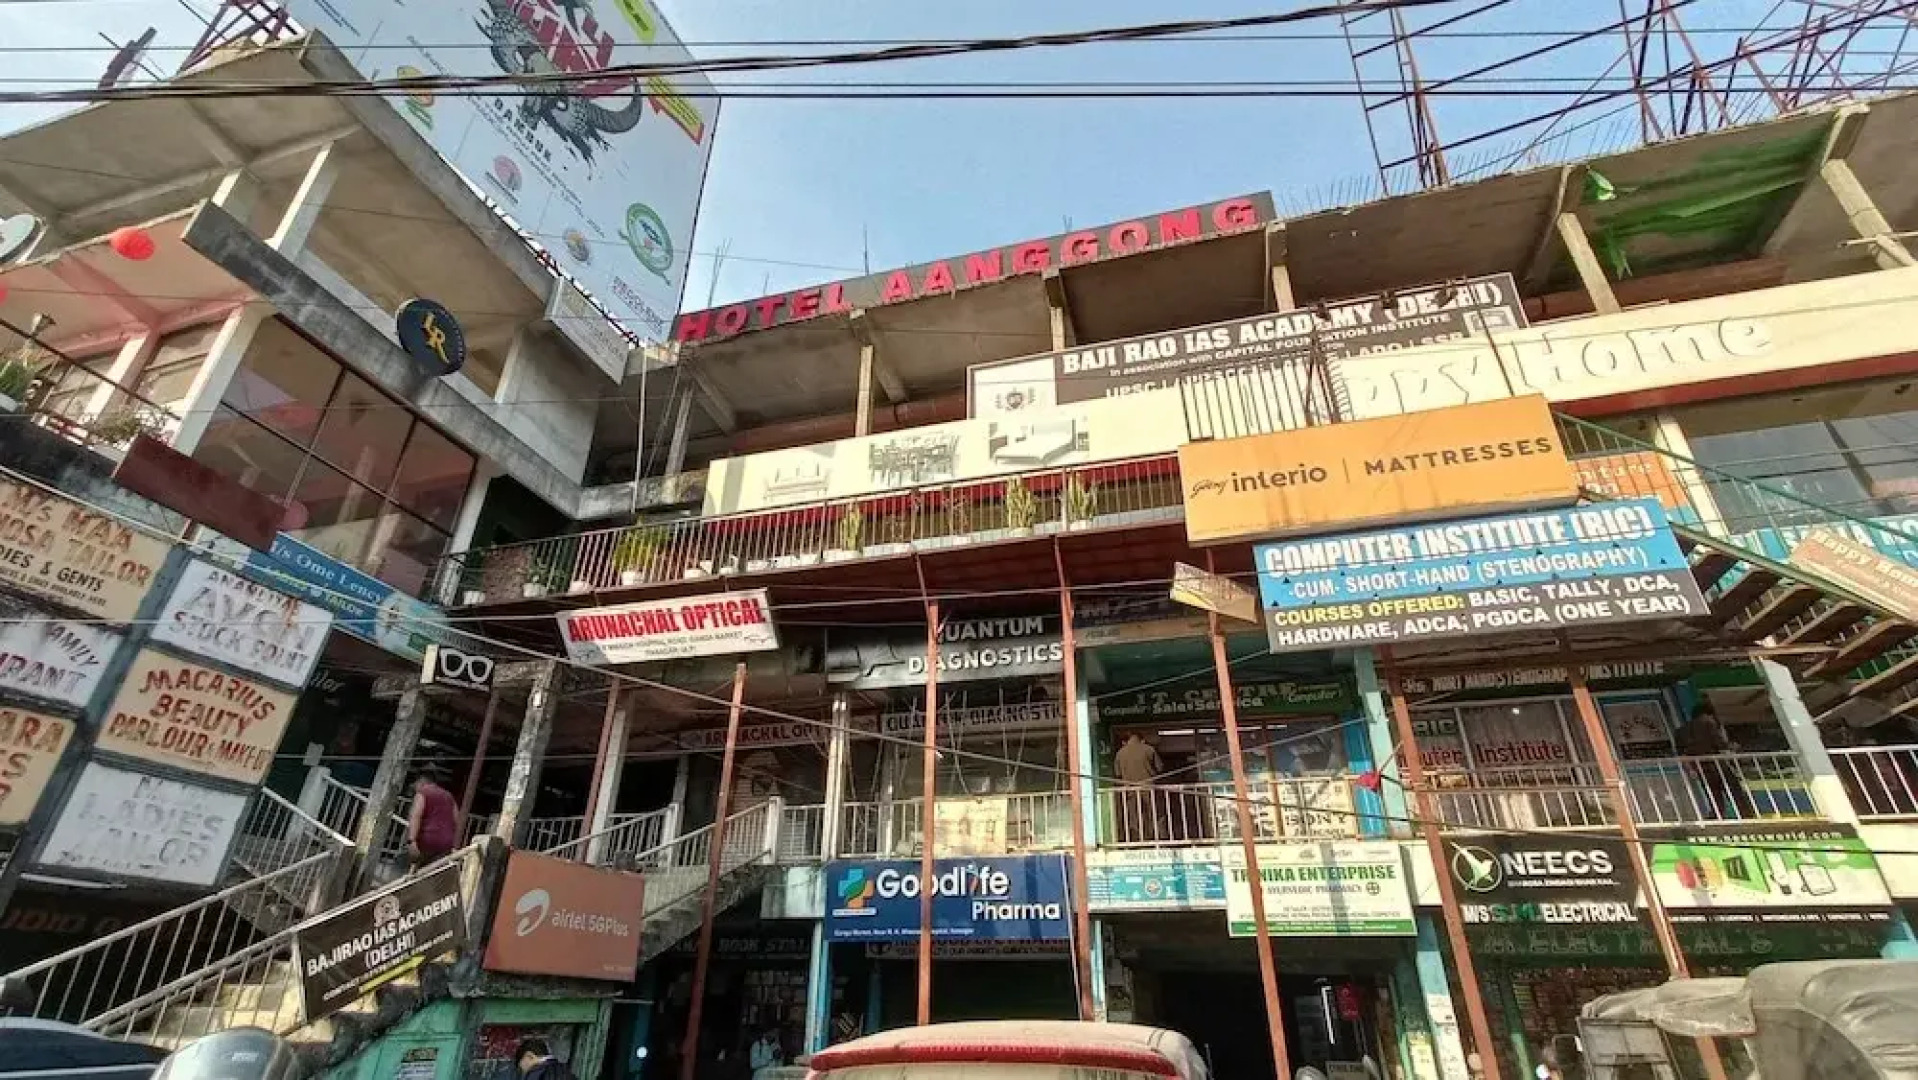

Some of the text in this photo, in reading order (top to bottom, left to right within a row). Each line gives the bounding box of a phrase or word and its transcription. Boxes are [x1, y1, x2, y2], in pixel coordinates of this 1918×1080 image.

[677, 284, 853, 342] HOTEL
[880, 199, 1259, 302] AANGGONG
[1063, 347, 1118, 375] BAJI
[1123, 336, 1177, 364] RAO
[1183, 327, 1231, 353] IAS
[1384, 281, 1503, 322] (DEHI)
[1123, 358, 1187, 375] association
[1188, 353, 1213, 364] with
[1215, 344, 1272, 359] CAPITAL
[1275, 327, 1369, 350] FOUNATION
[1371, 313, 1452, 335] INSTITUTE
[1231, 462, 1328, 492] interio
[1364, 436, 1553, 476] MATTRESSES
[1265, 535, 1412, 577] COMPUTER
[1413, 515, 1571, 558] INSTITUTE
[57, 567, 105, 592] GENTS
[1346, 561, 1470, 594] SHORT-HAND
[1477, 547, 1649, 584] (STENOGRAPHY)
[567, 598, 767, 642] ARUNACHAL OPTICAL
[1275, 573, 1681, 627] COURSES OFFERED: BASIC, TALLY, DCA,
[1277, 593, 1692, 646] HARDWARE, ADCA, PGDCA (ONE YEAR)
[936, 616, 1043, 643] UANTUM
[138, 668, 276, 722] MACARIUS
[1184, 682, 1297, 702] CETRE
[108, 712, 209, 758] PARLOUR
[150, 693, 254, 738] BEAUTY
[1413, 718, 1456, 737] RIC
[1475, 739, 1565, 766] Institute
[876, 862, 1010, 898] Godlife
[1299, 864, 1398, 882] ENTERPRISE
[1500, 849, 1614, 876] NEECS
[552, 909, 587, 931] airtel
[971, 902, 1062, 921] Pharma
[1541, 901, 1639, 924] ELECTRICAL
[306, 933, 373, 977] BAJIRAO
[374, 922, 397, 945] IAS
[398, 892, 459, 932] ACADEMY
[364, 931, 417, 969] (DELHI)
